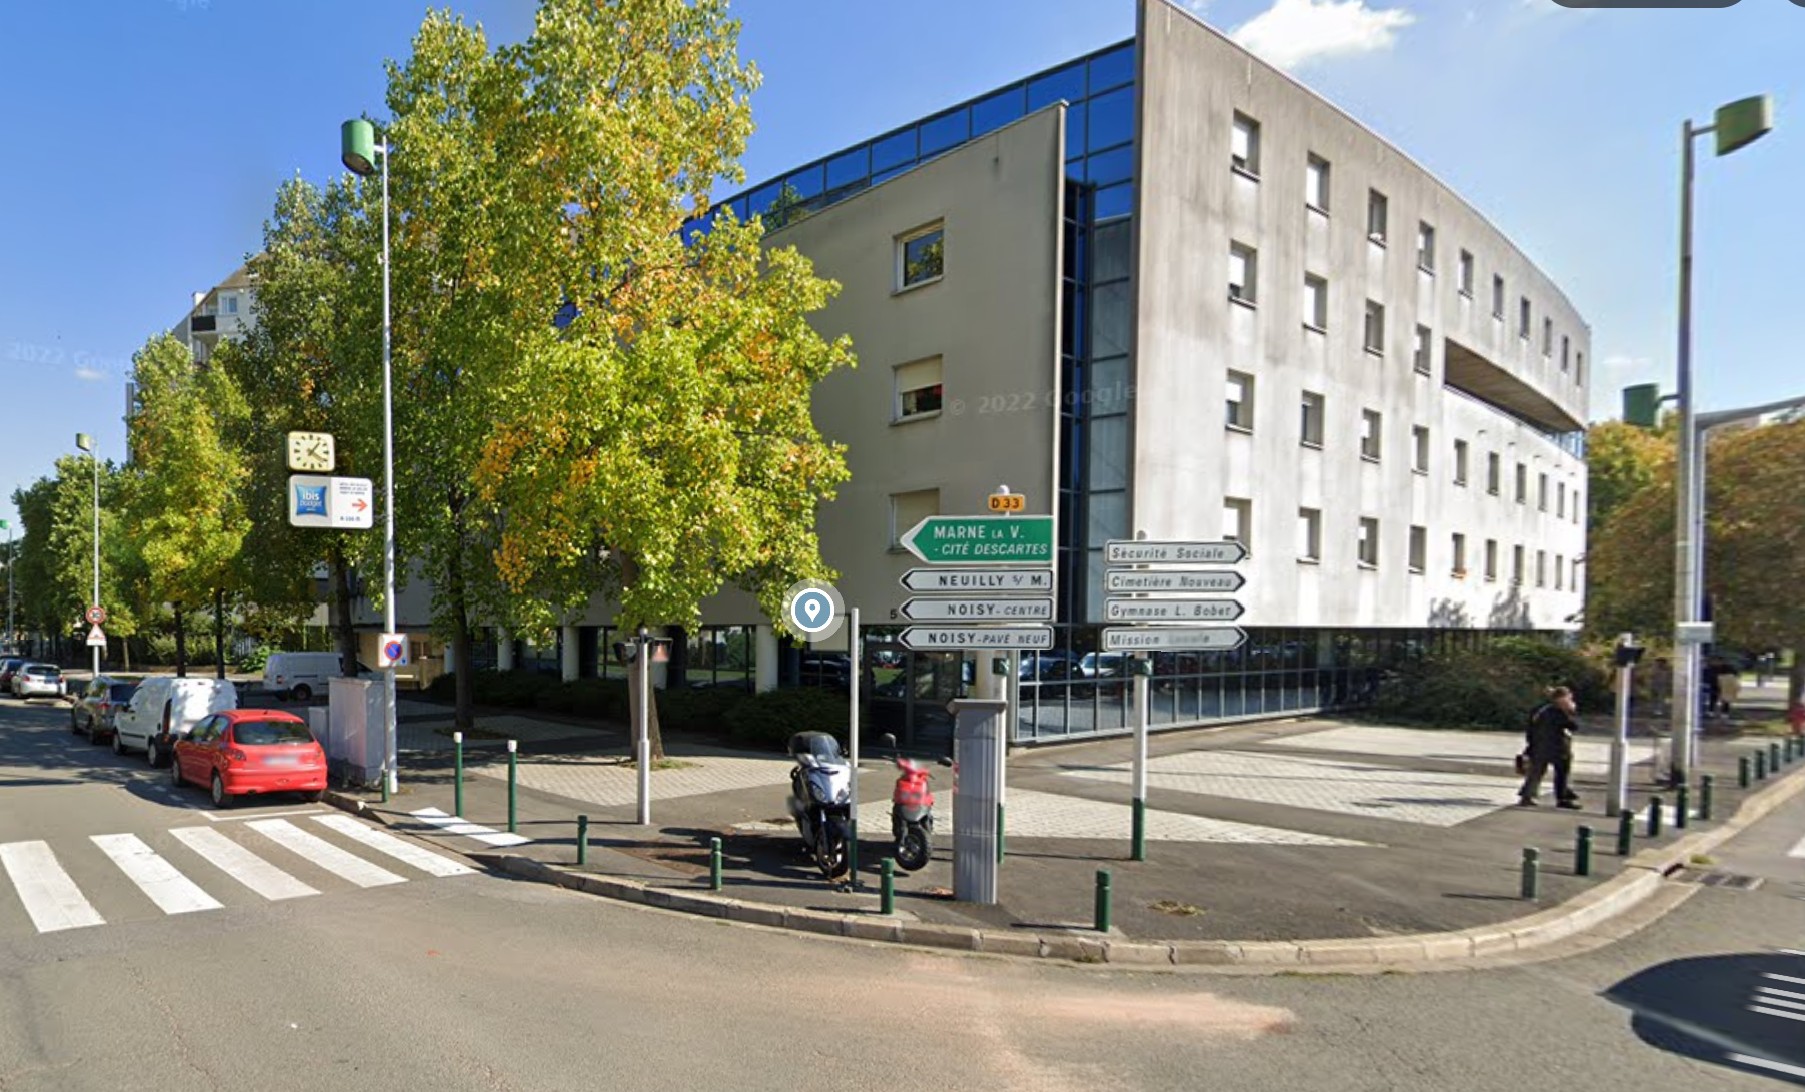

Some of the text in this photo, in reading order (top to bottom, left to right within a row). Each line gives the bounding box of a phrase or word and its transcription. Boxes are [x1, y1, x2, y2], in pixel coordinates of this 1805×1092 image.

[302, 491, 320, 501] ibis
[991, 498, 1020, 509] D 33
[934, 525, 1025, 539] MARNE LA V.
[941, 540, 969, 555] CITÉ
[974, 543, 1048, 555] DESCARTES
[1176, 547, 1224, 559] Sociale
[939, 575, 1004, 586] NEUILLY
[1031, 575, 1047, 586] M.
[1178, 576, 1232, 587] Nouveau
[889, 609, 898, 620] 5
[1110, 605, 1167, 618] Gymnase
[1018, 634, 1047, 644] NEUF
[1110, 635, 1160, 645] Mission
